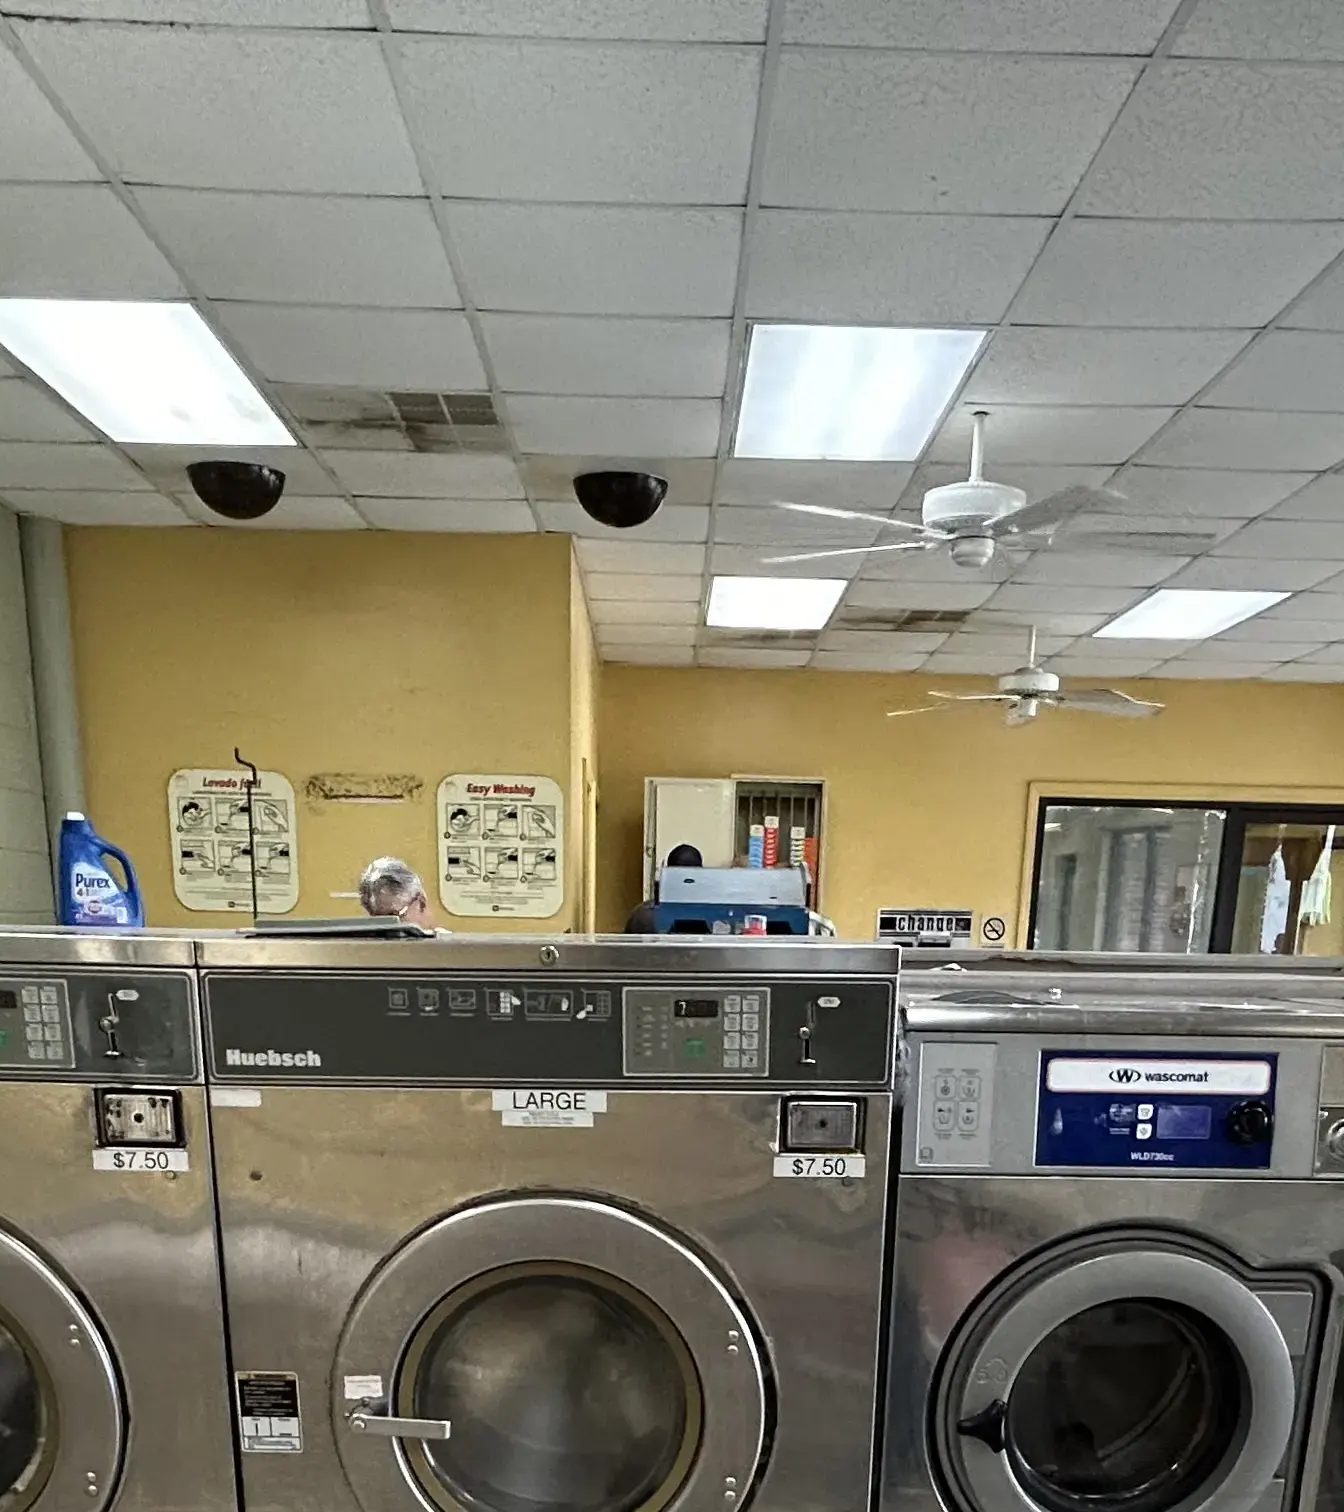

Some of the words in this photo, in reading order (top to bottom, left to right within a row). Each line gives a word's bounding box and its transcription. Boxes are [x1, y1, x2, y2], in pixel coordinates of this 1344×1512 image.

[202, 776, 238, 788] Lavado
[467, 783, 491, 797] Easy
[493, 784, 536, 797] Washing
[75, 873, 110, 889] Purex
[897, 914, 954, 932] change
[225, 1048, 322, 1067] Huebsch
[1144, 1071, 1209, 1082] wascomat
[513, 1091, 587, 1110] LARGE
[113, 1151, 169, 1170] $7.50
[792, 1157, 846, 1177] $7.50
